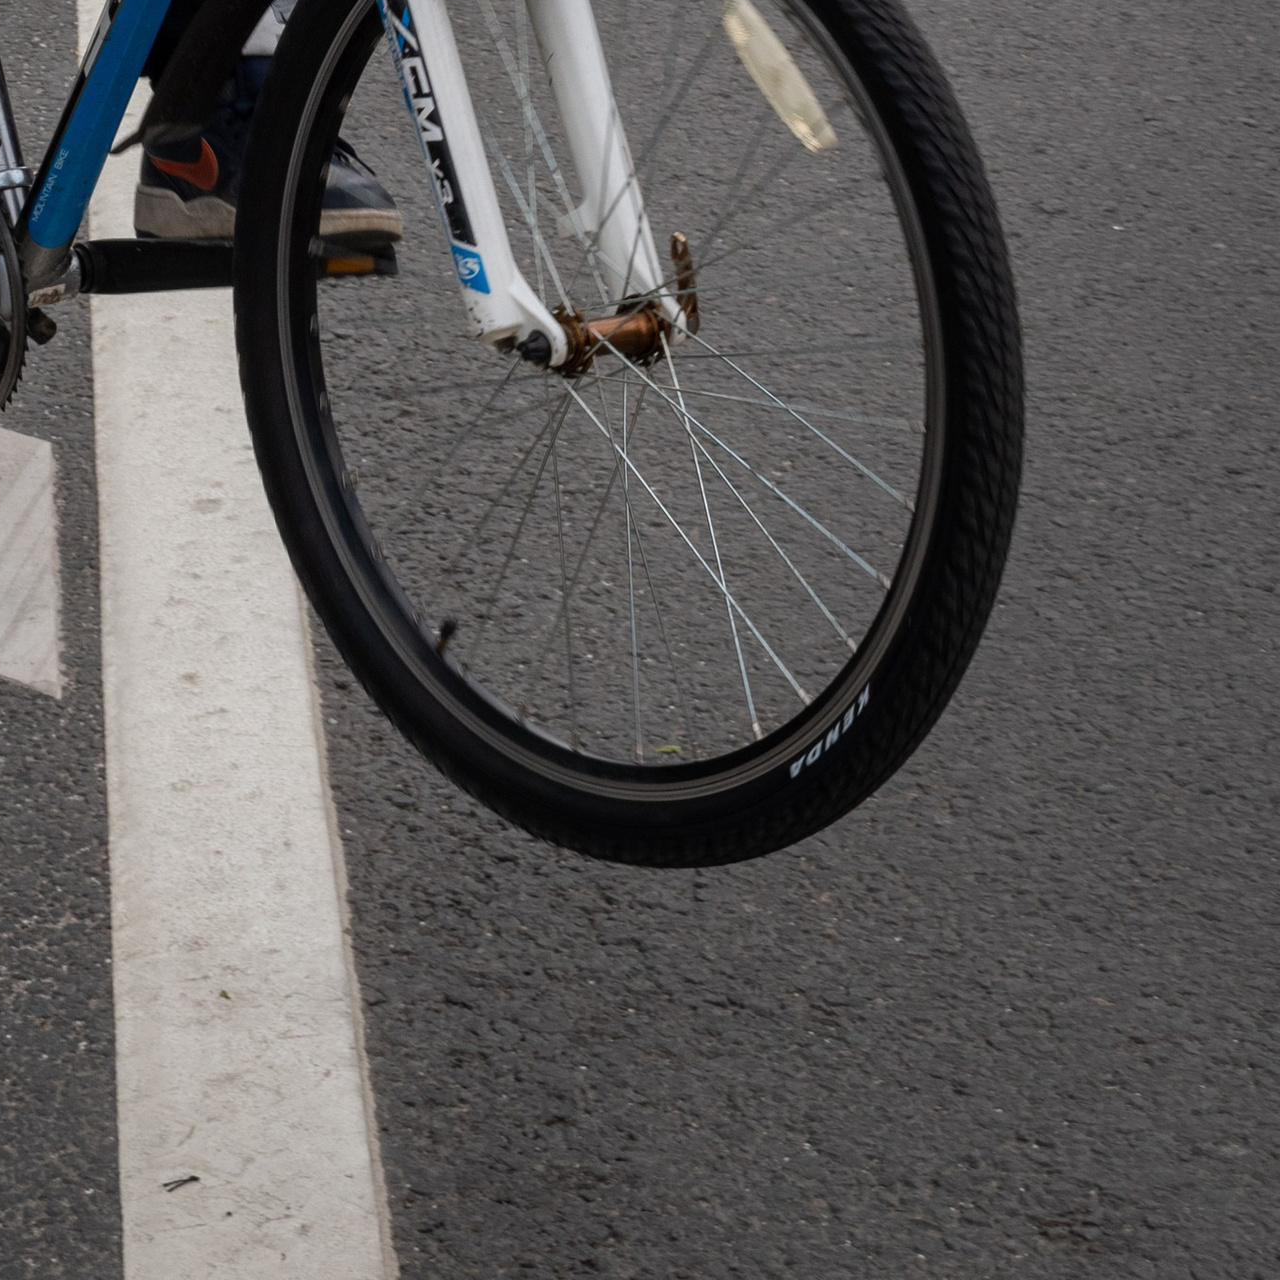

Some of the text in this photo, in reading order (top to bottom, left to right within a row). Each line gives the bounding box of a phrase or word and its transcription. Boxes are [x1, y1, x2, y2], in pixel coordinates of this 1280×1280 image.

[32, 148, 70, 222] MOUNTAIN BIKE
[789, 682, 869, 779] KENDA
